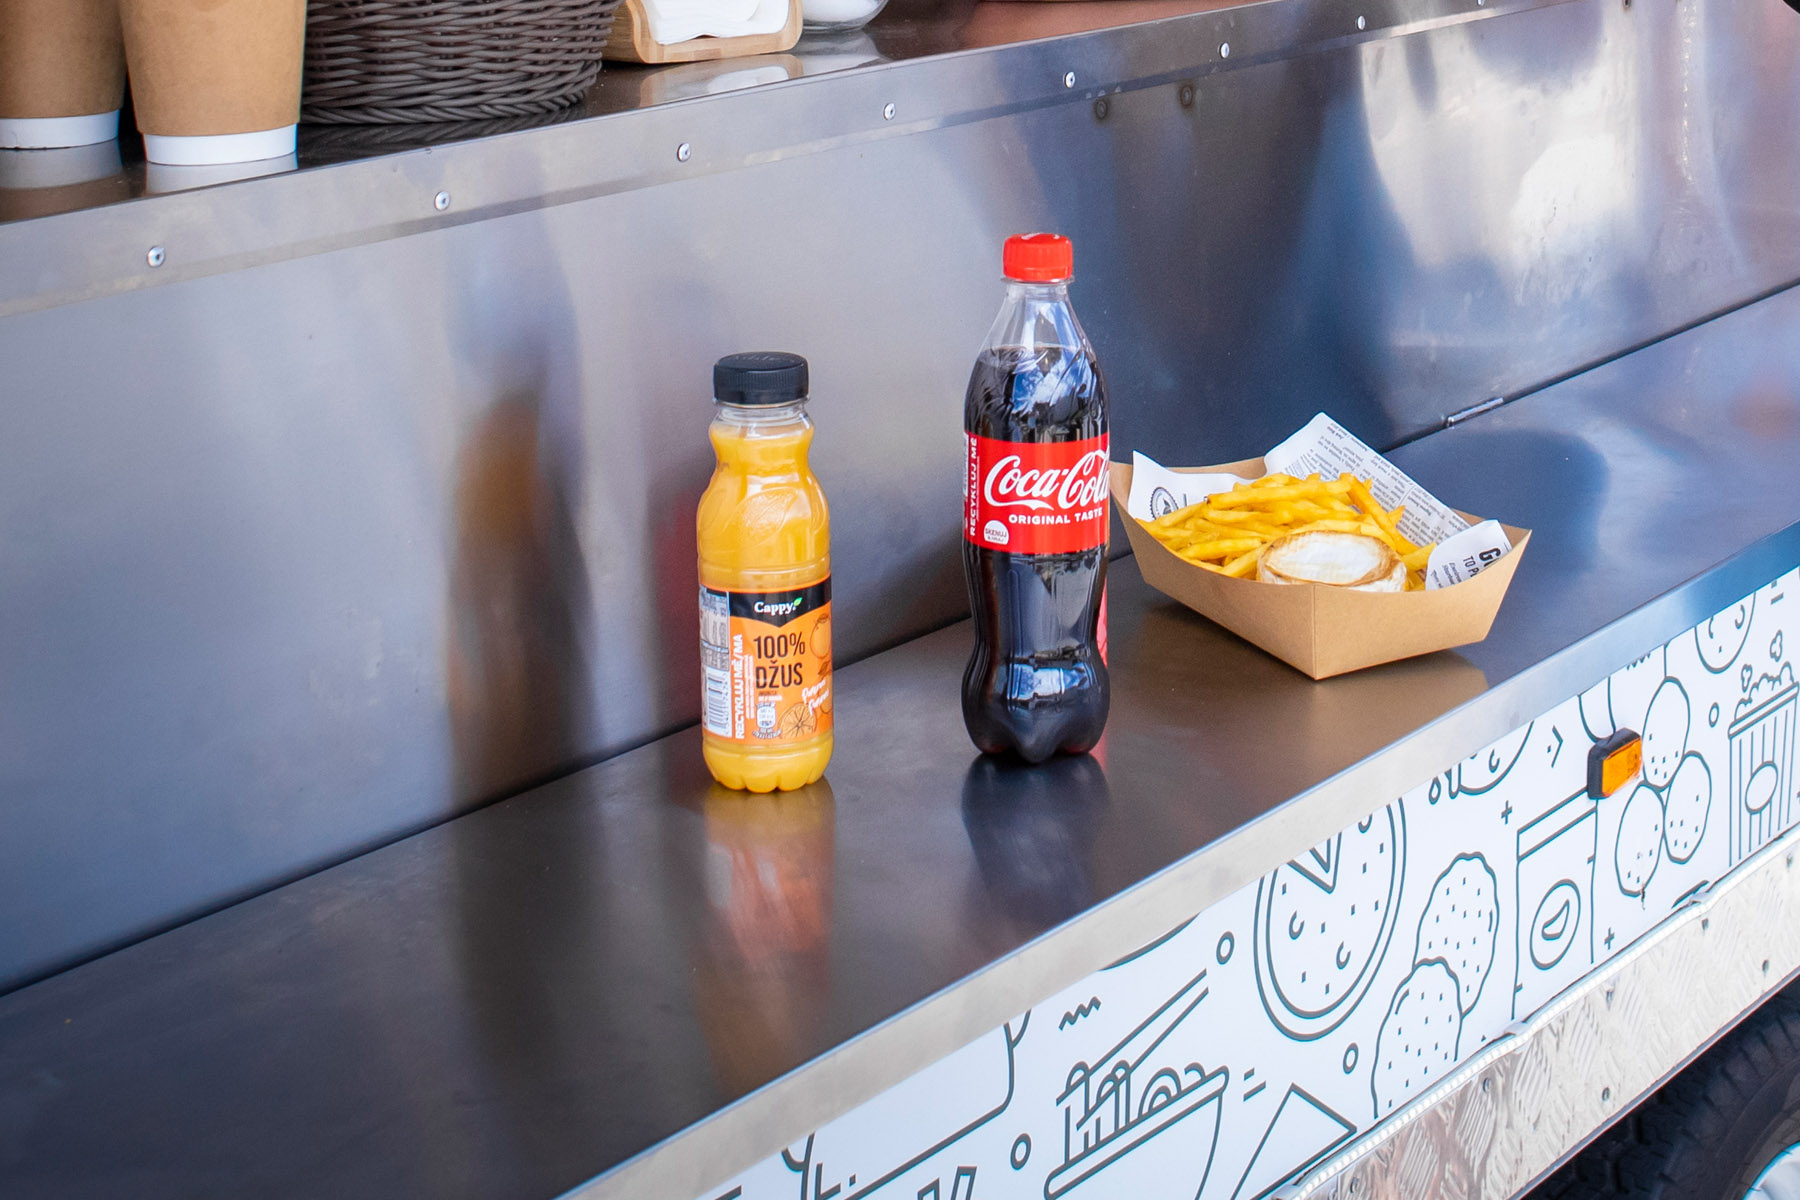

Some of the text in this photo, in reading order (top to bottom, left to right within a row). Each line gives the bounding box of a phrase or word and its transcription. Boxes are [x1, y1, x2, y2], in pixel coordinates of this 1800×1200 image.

[1008, 507, 1103, 525] ORIGINAL TASTE
[754, 601, 794, 616] Cappy
[753, 631, 806, 659] 100%
[755, 659, 803, 689] DŽUS
